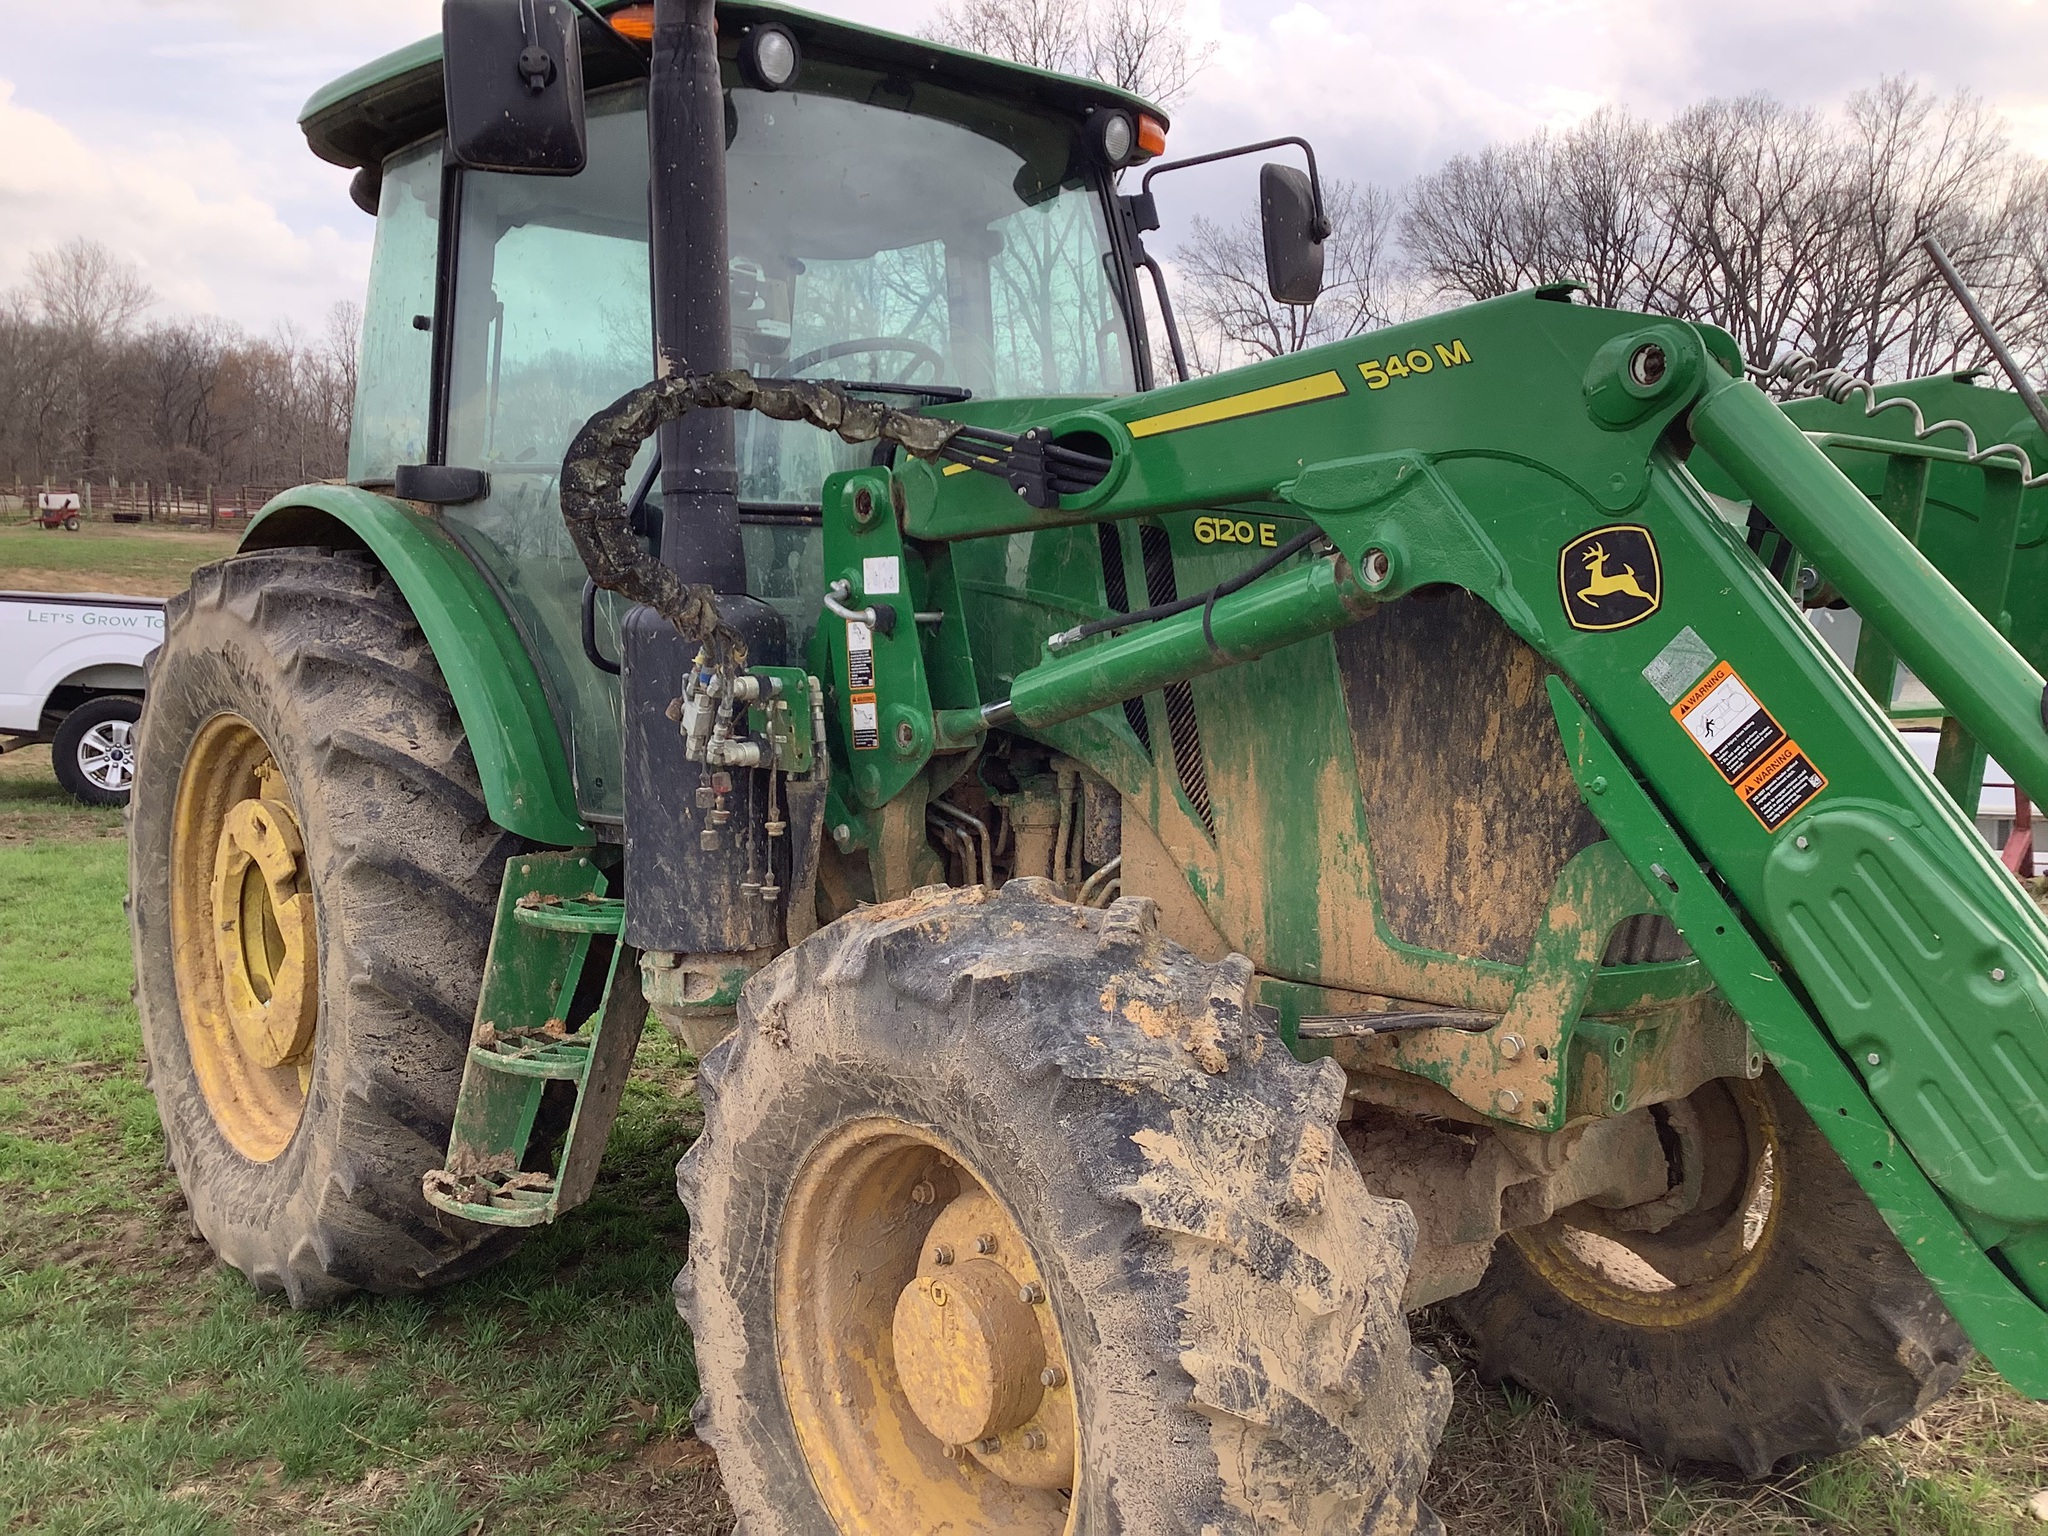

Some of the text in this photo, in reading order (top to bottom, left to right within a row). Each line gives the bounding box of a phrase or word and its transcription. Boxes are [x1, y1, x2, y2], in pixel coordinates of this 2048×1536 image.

[1357, 339, 1473, 390] 540 M
[1194, 516, 1278, 547] 6120 E
[1688, 670, 1725, 705] WARNING
[1753, 749, 1792, 784] WARNING
